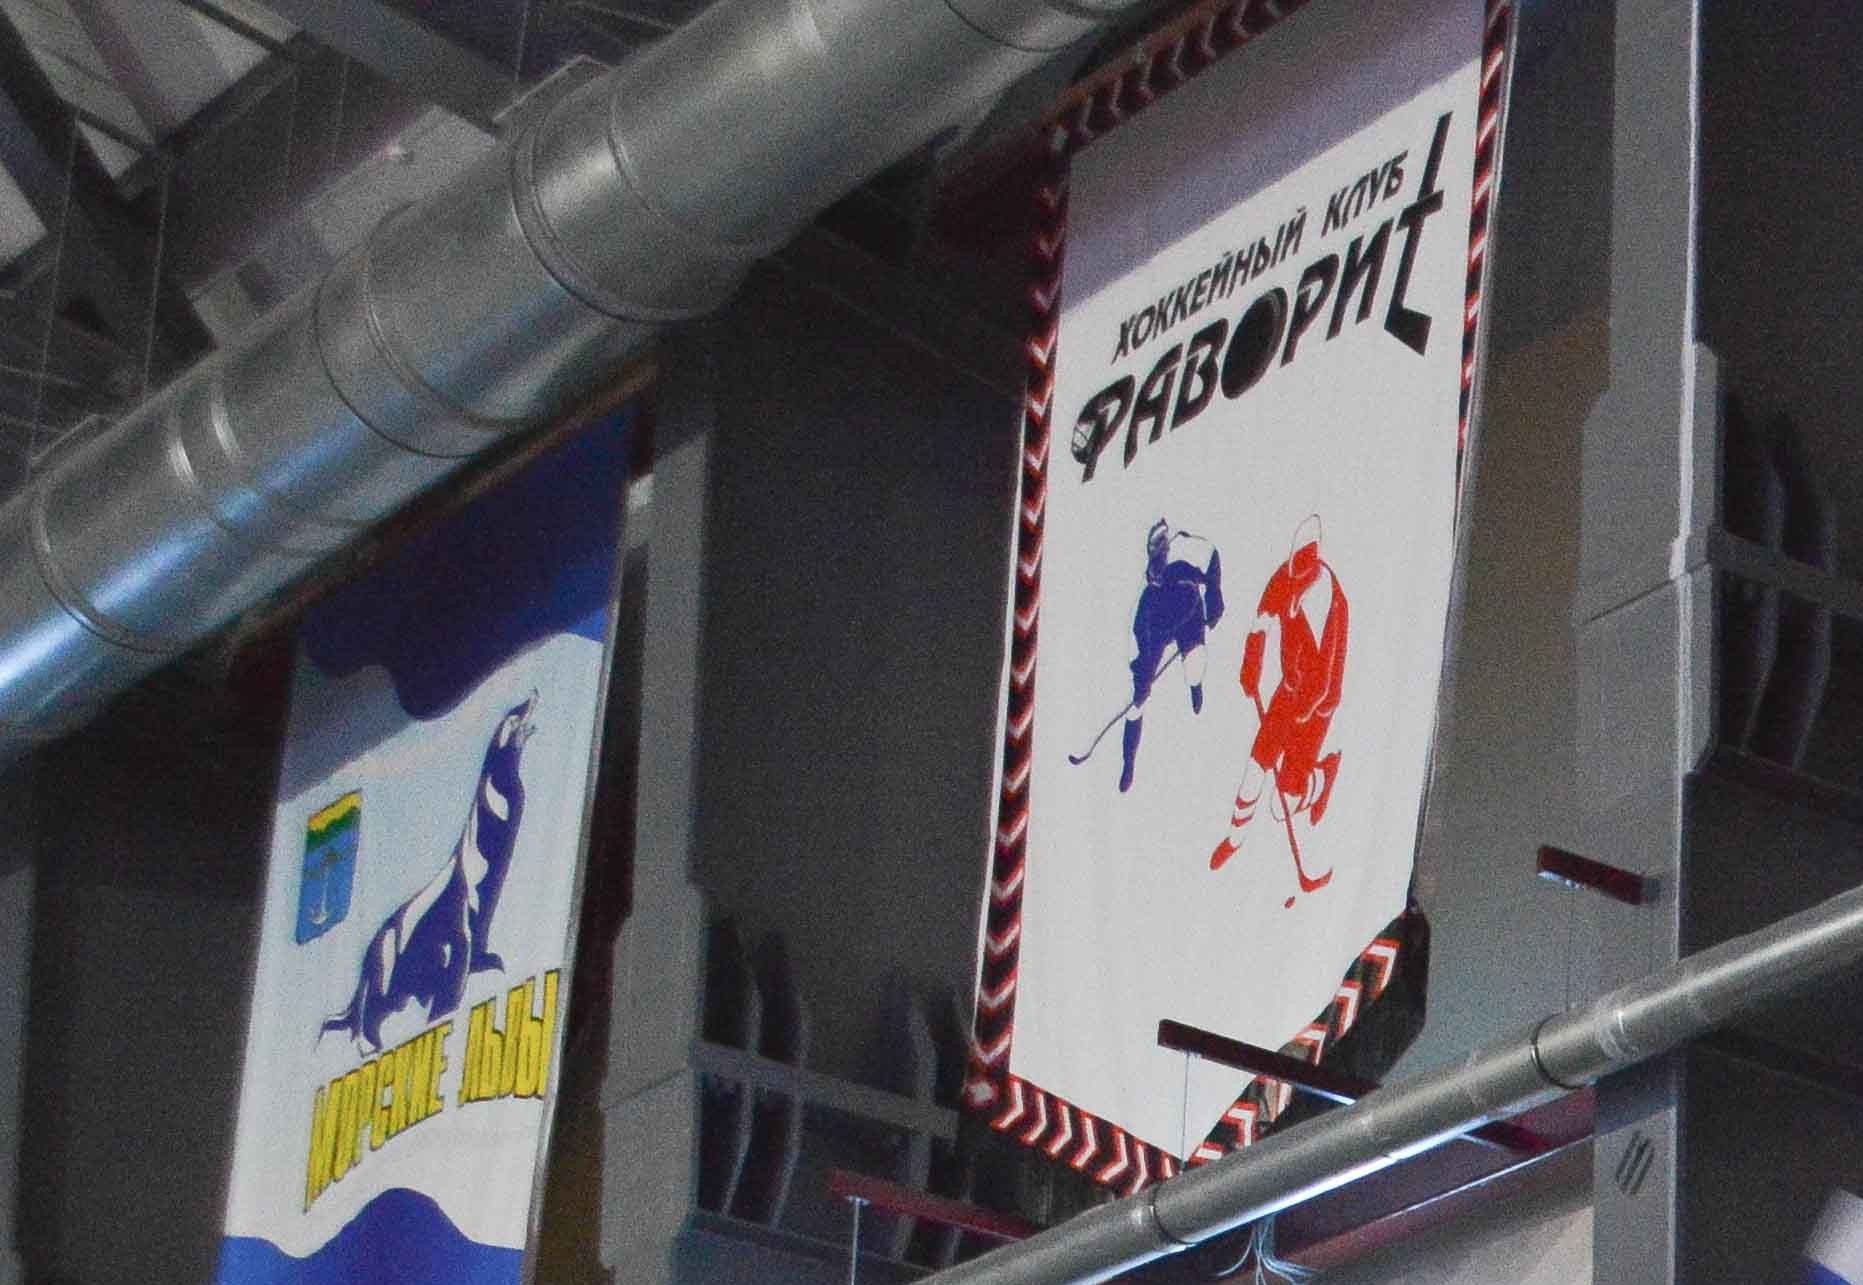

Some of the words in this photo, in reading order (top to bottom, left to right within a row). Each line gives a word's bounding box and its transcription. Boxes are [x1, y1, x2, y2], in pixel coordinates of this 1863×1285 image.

[1111, 207, 1307, 365] ХОККЕЙНЫЙ
[1320, 149, 1409, 238] КЛУБ
[303, 1018, 454, 1215] МОРСКИЕ
[457, 967, 560, 1108] ЛЬВЫ
